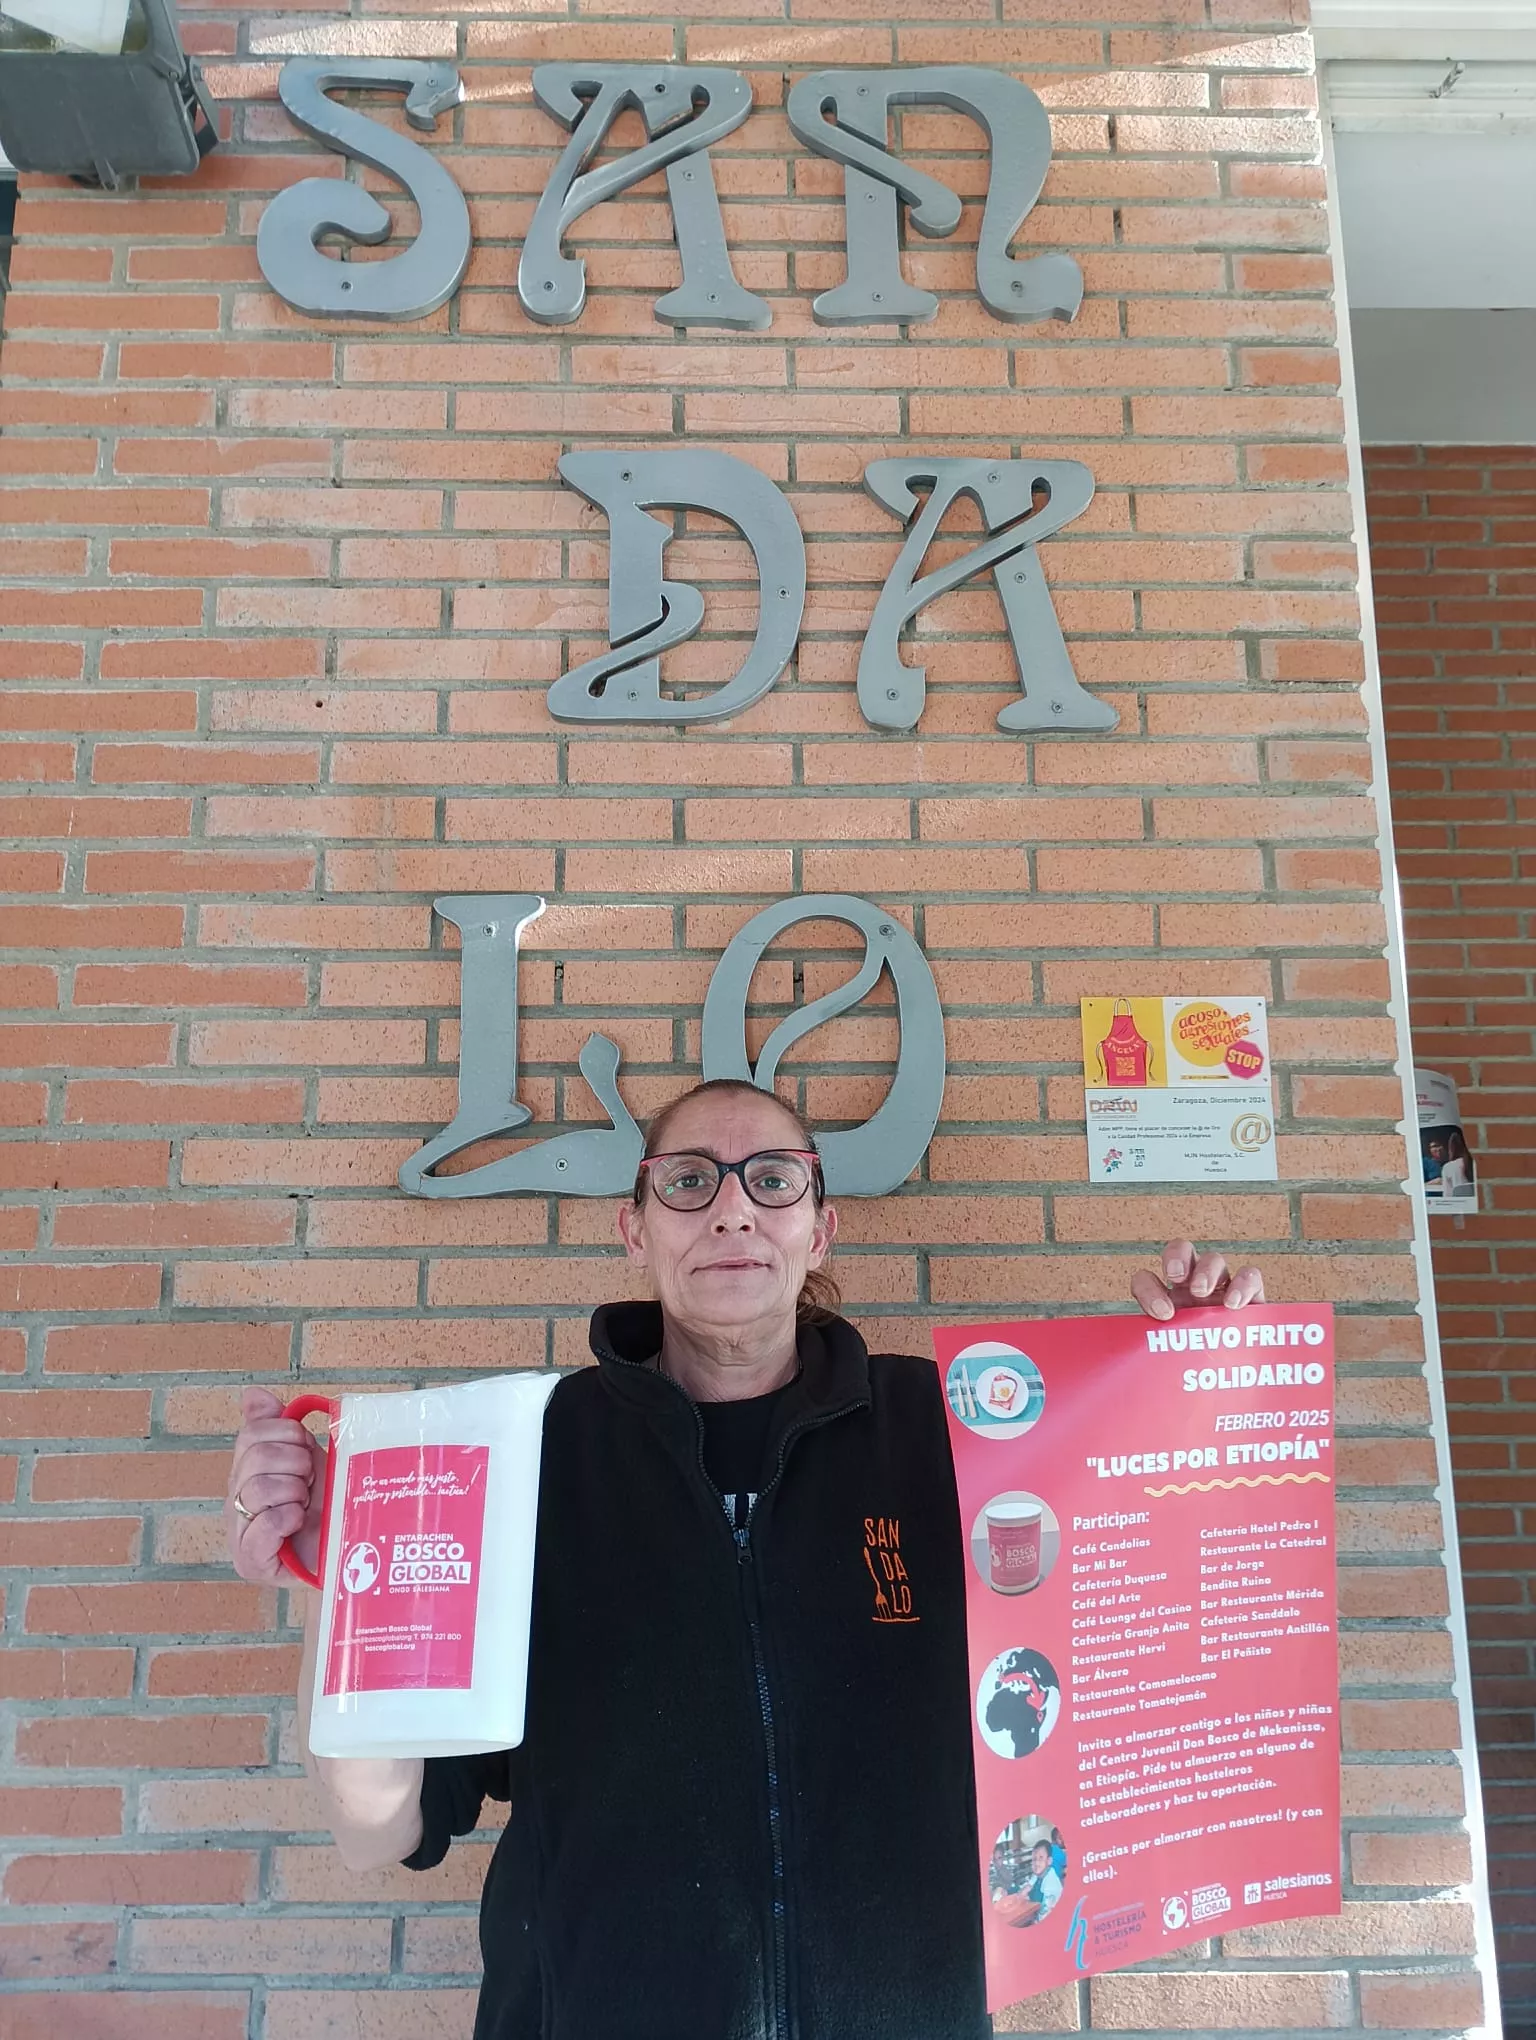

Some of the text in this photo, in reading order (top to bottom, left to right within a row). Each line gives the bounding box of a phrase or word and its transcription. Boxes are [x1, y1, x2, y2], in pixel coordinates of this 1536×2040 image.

[256, 58, 1084, 330] SAN
[546, 449, 1119, 734] DA
[398, 894, 946, 1198] LO
[1228, 1049, 1260, 1069] STOP
[1173, 1097, 1208, 1105] Zaragoza,
[1147, 1323, 1324, 1353] HUEVO FRITO
[1183, 1363, 1324, 1392] SOLIDARIO
[1215, 1409, 1329, 1432] FEBRERO 2025
[1087, 1435, 1330, 1478] "LUCES POR ETIOPÍA"
[1073, 1511, 1150, 1531] Participan:
[1200, 1526, 1247, 1539] Cafetería
[1250, 1523, 1277, 1533] Hotel
[1280, 1522, 1311, 1531] Pedro
[394, 1534, 453, 1543] ENTARACHEN
[864, 1518, 900, 1548] SAN
[393, 1543, 464, 1561] BOSCO
[1072, 1543, 1096, 1556] Café
[1200, 1536, 1326, 1557] Restaurante La Catedral
[391, 1564, 467, 1582] GLOBAL
[880, 1551, 908, 1581] DA
[1072, 1559, 1127, 1574] Bar Mi Bar
[1200, 1560, 1264, 1575] Bar de Jorge
[389, 1585, 450, 1594] ONGD SALESIANA
[1072, 1571, 1167, 1592] Cafetería Duquesa
[1200, 1581, 1239, 1592] Bendita
[891, 1584, 911, 1614] LO
[1072, 1593, 1141, 1611] Café del Arte
[1200, 1589, 1324, 1610] Bar Restaurante Mérida
[1072, 1604, 1192, 1629] Café Lounge del Casino
[1200, 1608, 1300, 1628] Cafetería Sanddalo
[1072, 1621, 1190, 1647] Cafetería Granja Anita
[1200, 1623, 1330, 1646] Bar Restaurante Antillón
[1072, 1649, 1135, 1666] Restaurante
[1200, 1653, 1218, 1663] Bar
[1221, 1650, 1231, 1660] El
[1072, 1667, 1128, 1684] Bar Álvaro
[1072, 1670, 1217, 1704] Restaurante Comomelocomo
[1072, 1690, 1207, 1722] Restaurante Tomatejamón
[1078, 1704, 1332, 1753] Invita a almorzar contigo a los niños y niñas
[1078, 1722, 1326, 1772] del Centro Juvenil Don Bosco de Mekanissa,
[1079, 1738, 1314, 1790] en Etiopía. Pide tu almuerzo en alguno de
[1079, 1765, 1253, 1809] los establecimientos hosteleros
[1080, 1779, 1277, 1828] colaboradores y haz tu aportación.
[1132, 1840, 1151, 1856] por
[1154, 1827, 1204, 1848] almorzar
[1206, 1821, 1226, 1833] con
[1229, 1810, 1282, 1829] nosotros!
[1286, 1809, 1298, 1823] (y
[1302, 1808, 1323, 1818] con
[1083, 1868, 1118, 1884] ellos).
[1264, 1872, 1332, 1891] salesianos
[1192, 1887, 1227, 1905] BOSCO
[1193, 1899, 1229, 1917] GLOBAL
[1103, 1924, 1142, 1942] TURISMO
